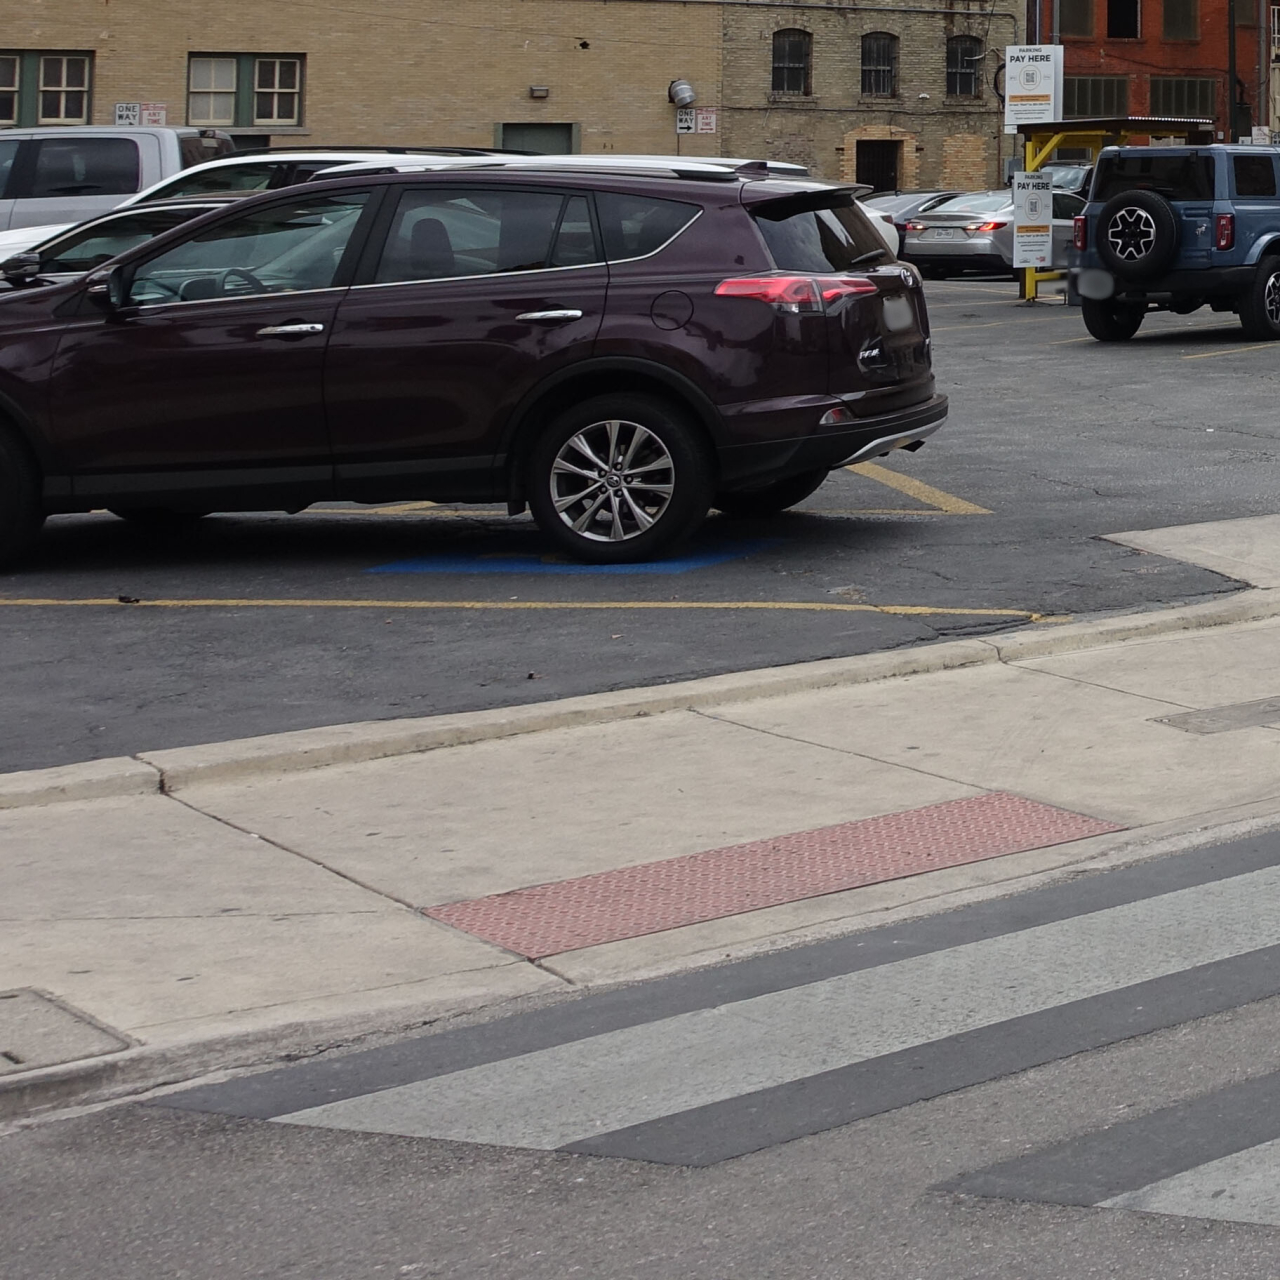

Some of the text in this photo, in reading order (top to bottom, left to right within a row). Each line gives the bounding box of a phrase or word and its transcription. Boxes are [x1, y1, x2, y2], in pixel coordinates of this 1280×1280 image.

[1009, 54, 1052, 63] PAY HERE
[117, 113, 138, 121] WAY
[1017, 182, 1050, 190] PAY HERE
